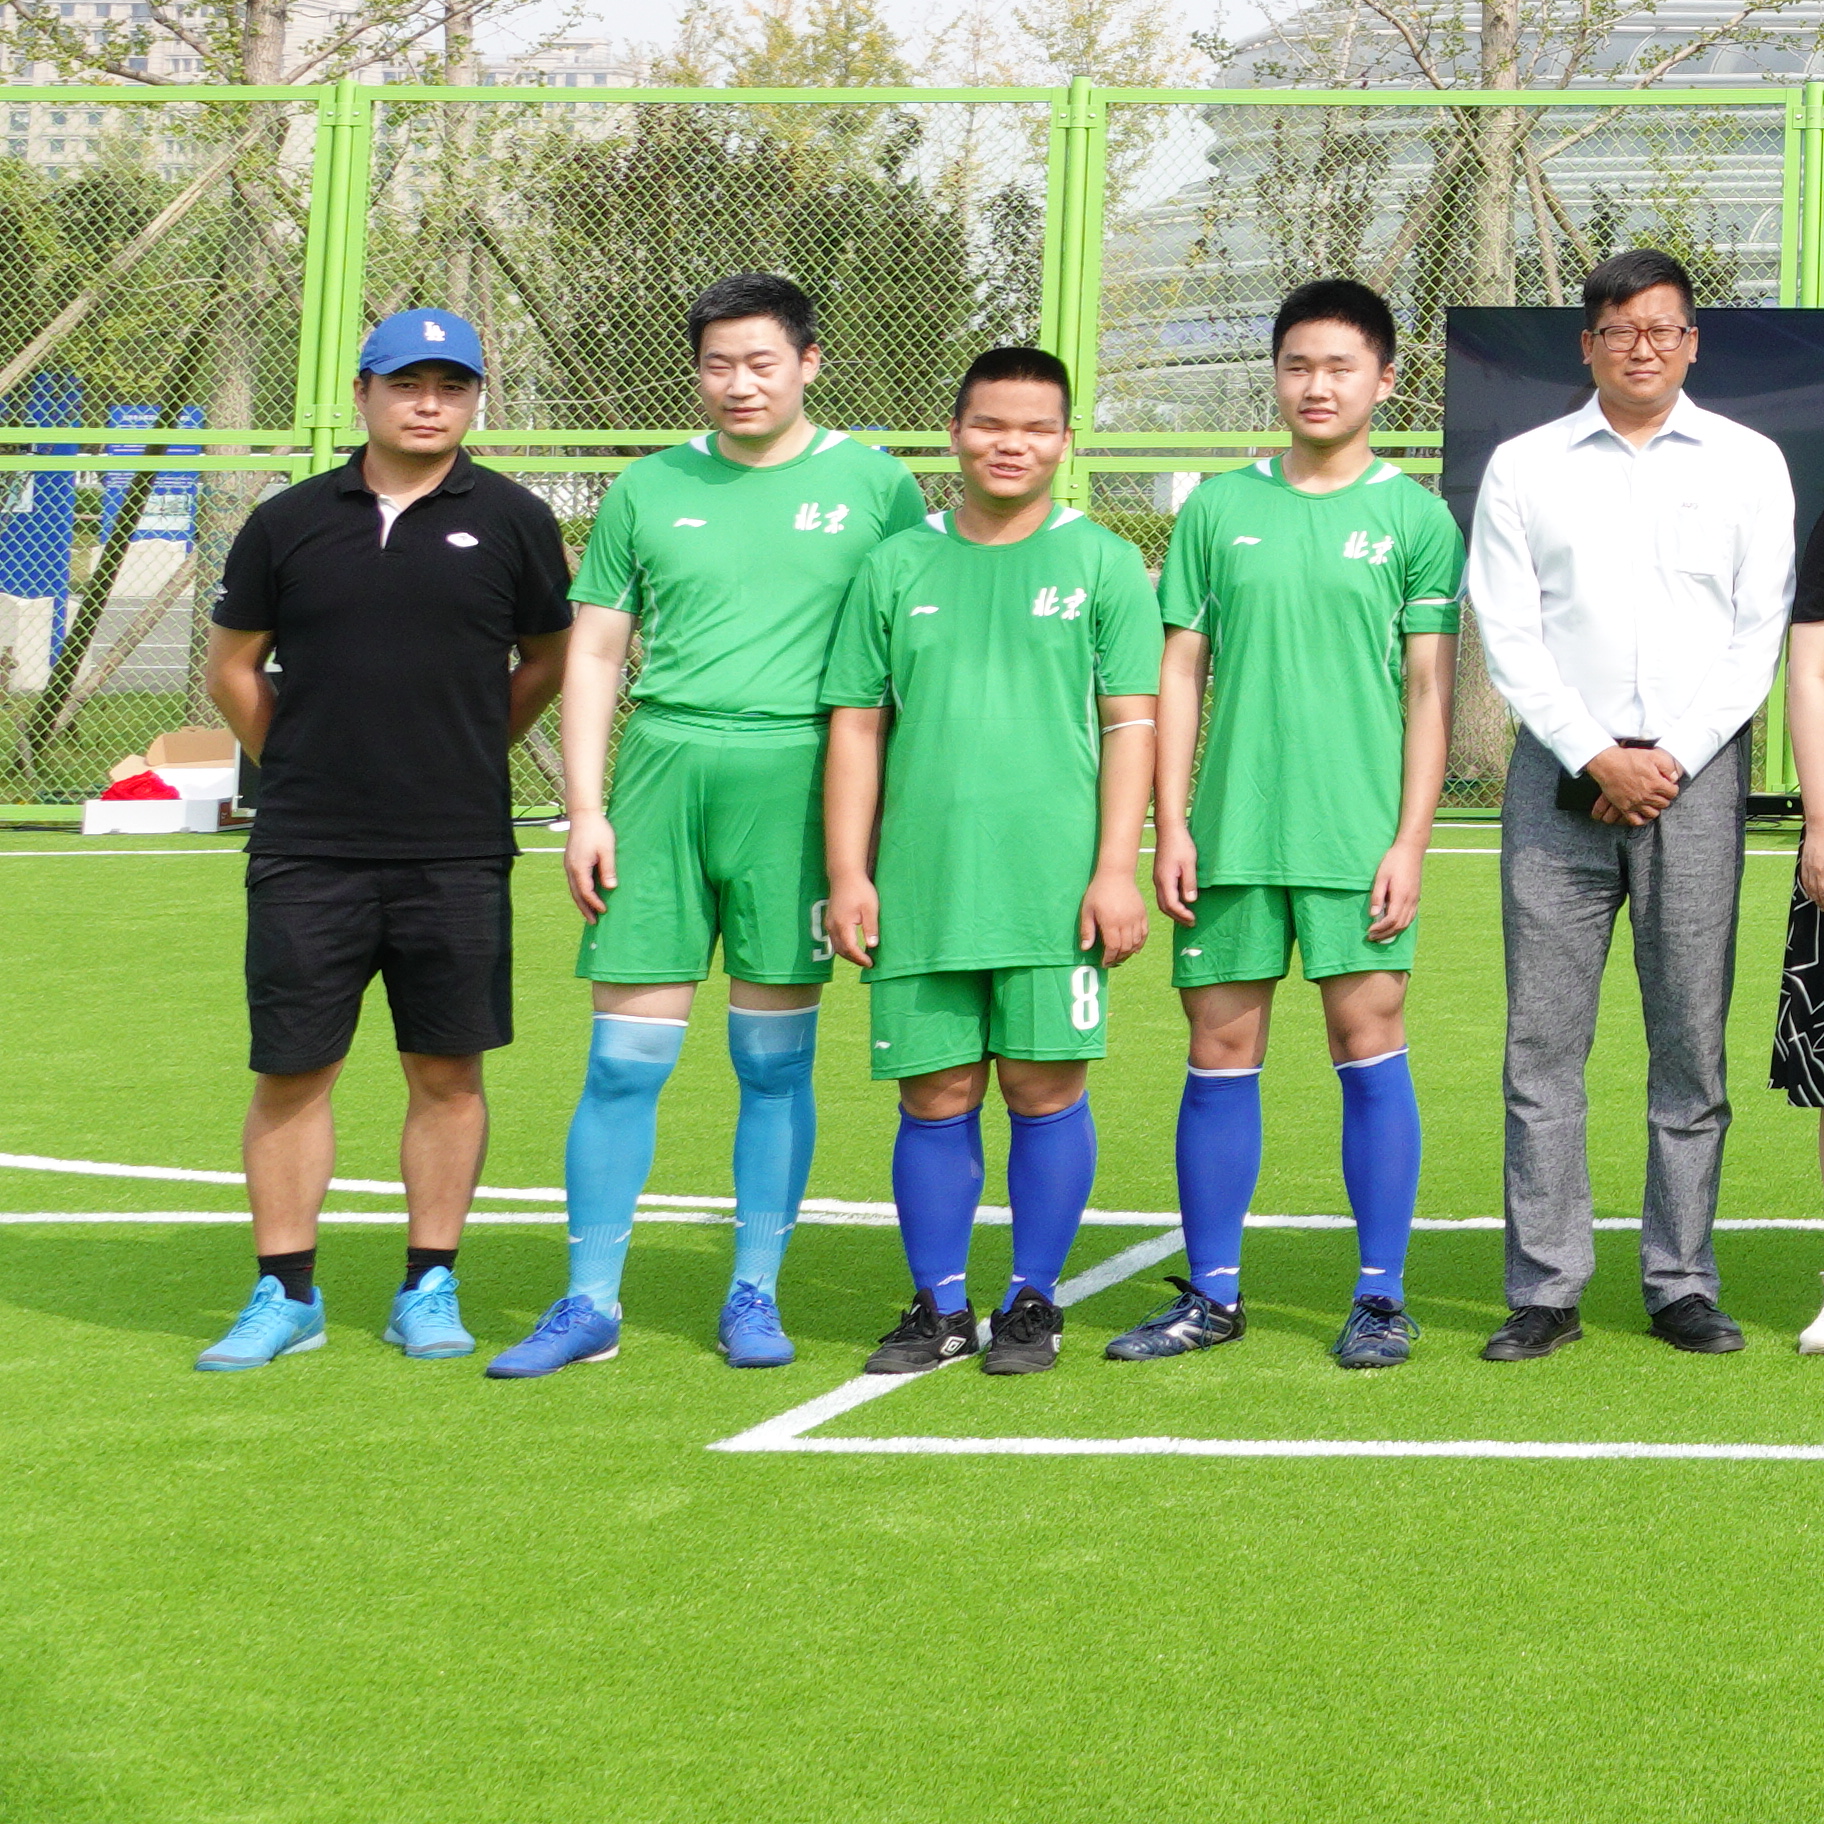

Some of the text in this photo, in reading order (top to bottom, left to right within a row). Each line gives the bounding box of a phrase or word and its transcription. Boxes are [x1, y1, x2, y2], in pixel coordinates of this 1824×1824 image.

[794, 501, 850, 534] 北京
[1343, 529, 1395, 566] 北京
[1032, 585, 1088, 621] 北京
[1071, 965, 1100, 1030] 8
